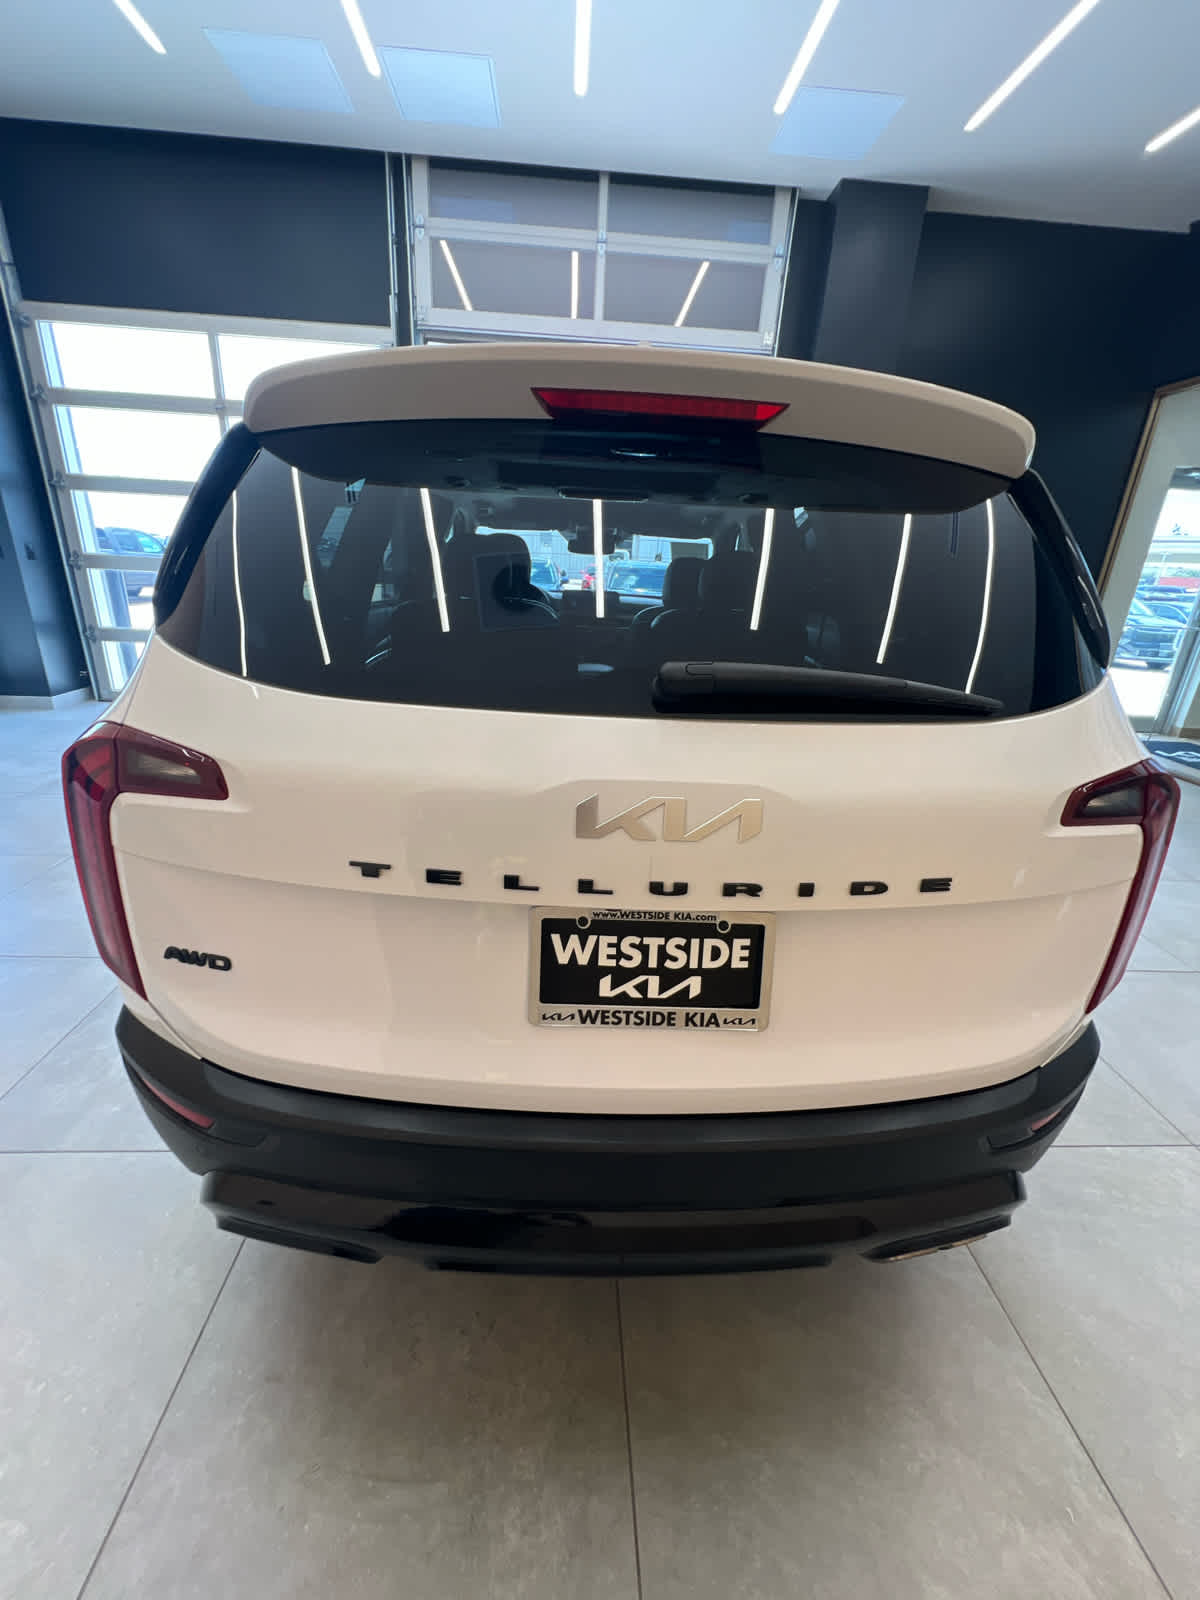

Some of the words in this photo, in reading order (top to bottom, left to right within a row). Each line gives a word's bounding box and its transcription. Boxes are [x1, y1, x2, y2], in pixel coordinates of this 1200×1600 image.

[349, 860, 952, 897] TELLURIDE
[164, 945, 231, 971] AWD
[550, 933, 751, 969] WESTSIDE
[599, 974, 702, 999] KIA
[578, 1009, 676, 1027] WESTSIDE
[684, 1012, 720, 1028] KIA
